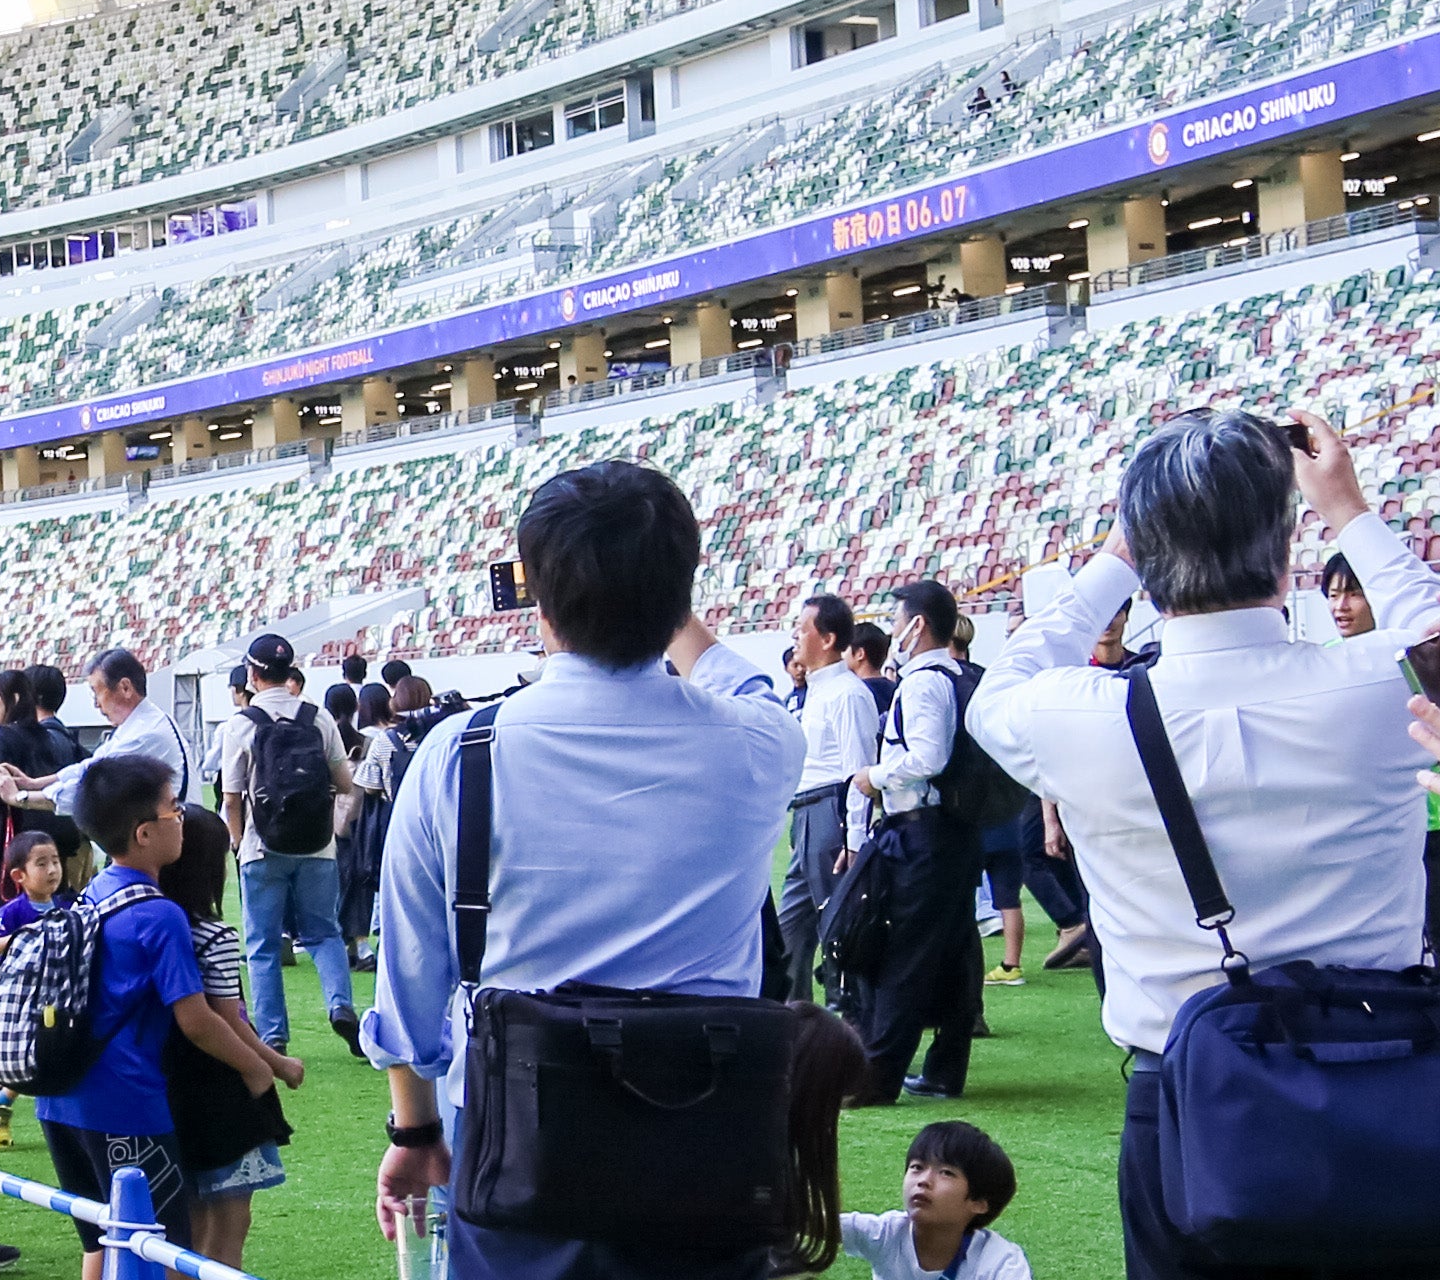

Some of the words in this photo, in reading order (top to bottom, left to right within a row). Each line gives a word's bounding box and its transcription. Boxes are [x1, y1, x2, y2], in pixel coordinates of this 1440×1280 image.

[1182, 104, 1256, 147] CRIACAO
[1260, 81, 1337, 125] SHINJUKU
[832, 205, 902, 252] 新宿の日
[906, 185, 967, 232] 06.07
[582, 282, 630, 310] CRIACAO
[633, 270, 680, 297] SHINJUKU
[262, 364, 305, 387] SHINJUKU
[305, 355, 330, 376] NIGHT
[331, 347, 374, 371] FOOTBALL
[96, 402, 130, 422] CRIACAO
[130, 396, 166, 415] SHINJUKU
